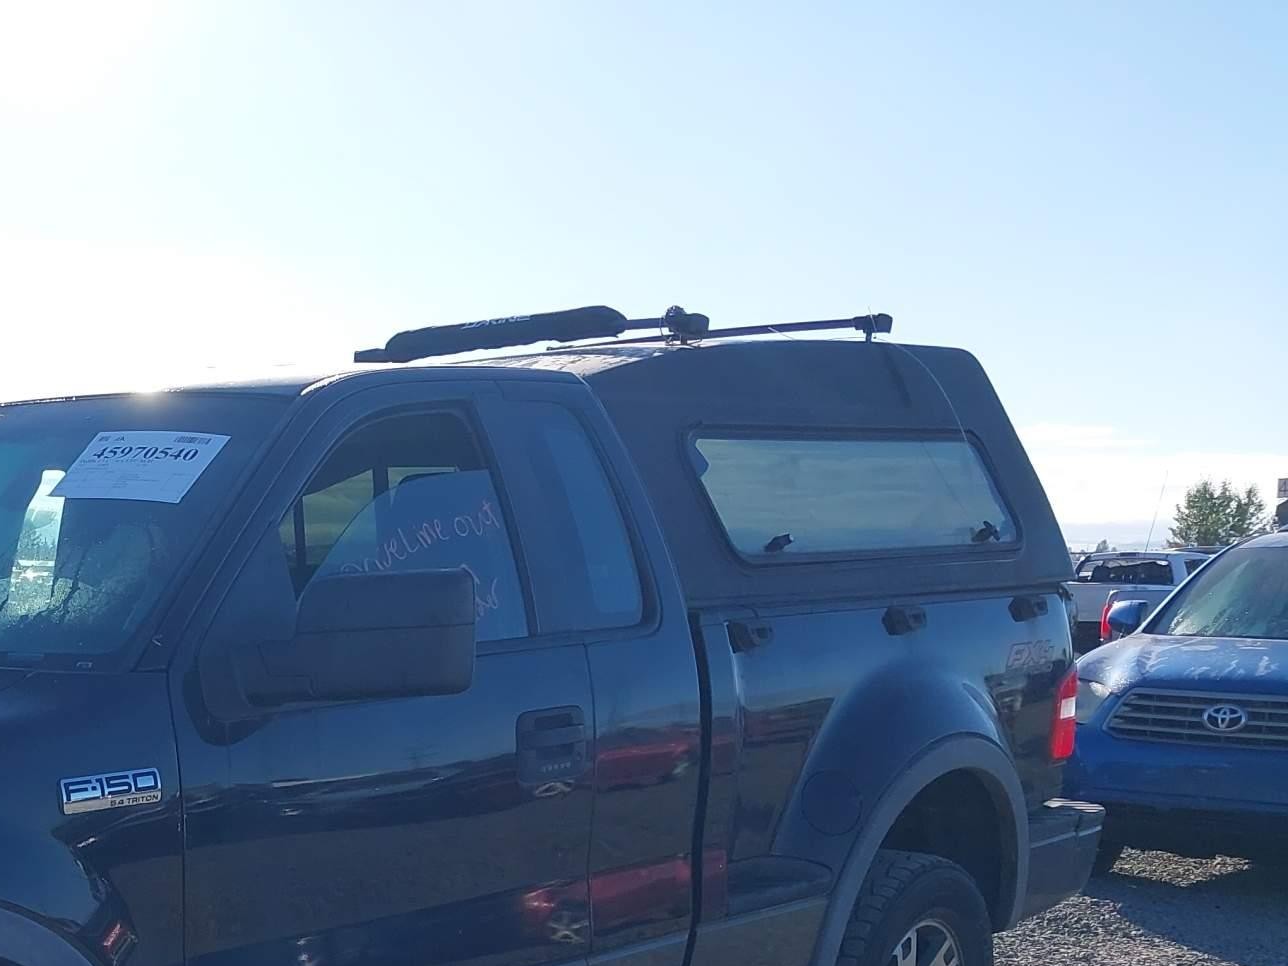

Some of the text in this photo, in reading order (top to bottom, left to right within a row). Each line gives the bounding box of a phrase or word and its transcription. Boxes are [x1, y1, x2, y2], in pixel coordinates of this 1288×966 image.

[92, 446, 199, 462] 45970540
[453, 499, 501, 537] out
[126, 794, 159, 805] TRITON
